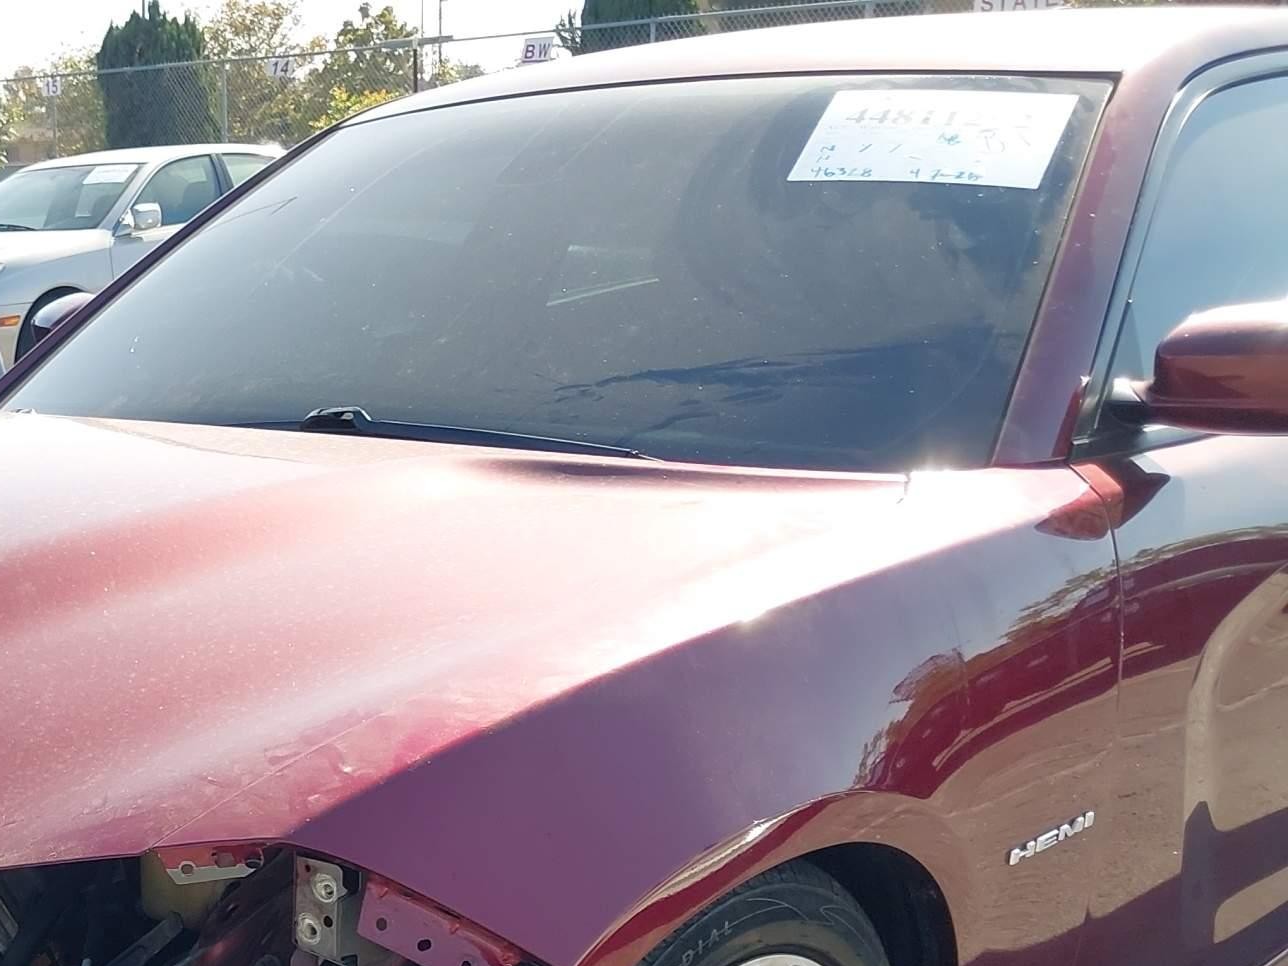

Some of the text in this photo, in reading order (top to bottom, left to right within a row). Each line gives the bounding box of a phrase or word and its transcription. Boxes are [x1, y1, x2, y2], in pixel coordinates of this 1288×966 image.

[524, 42, 551, 59] BW
[272, 60, 289, 76] 14
[45, 80, 58, 94] 15
[1009, 811, 1095, 866] HEMI
